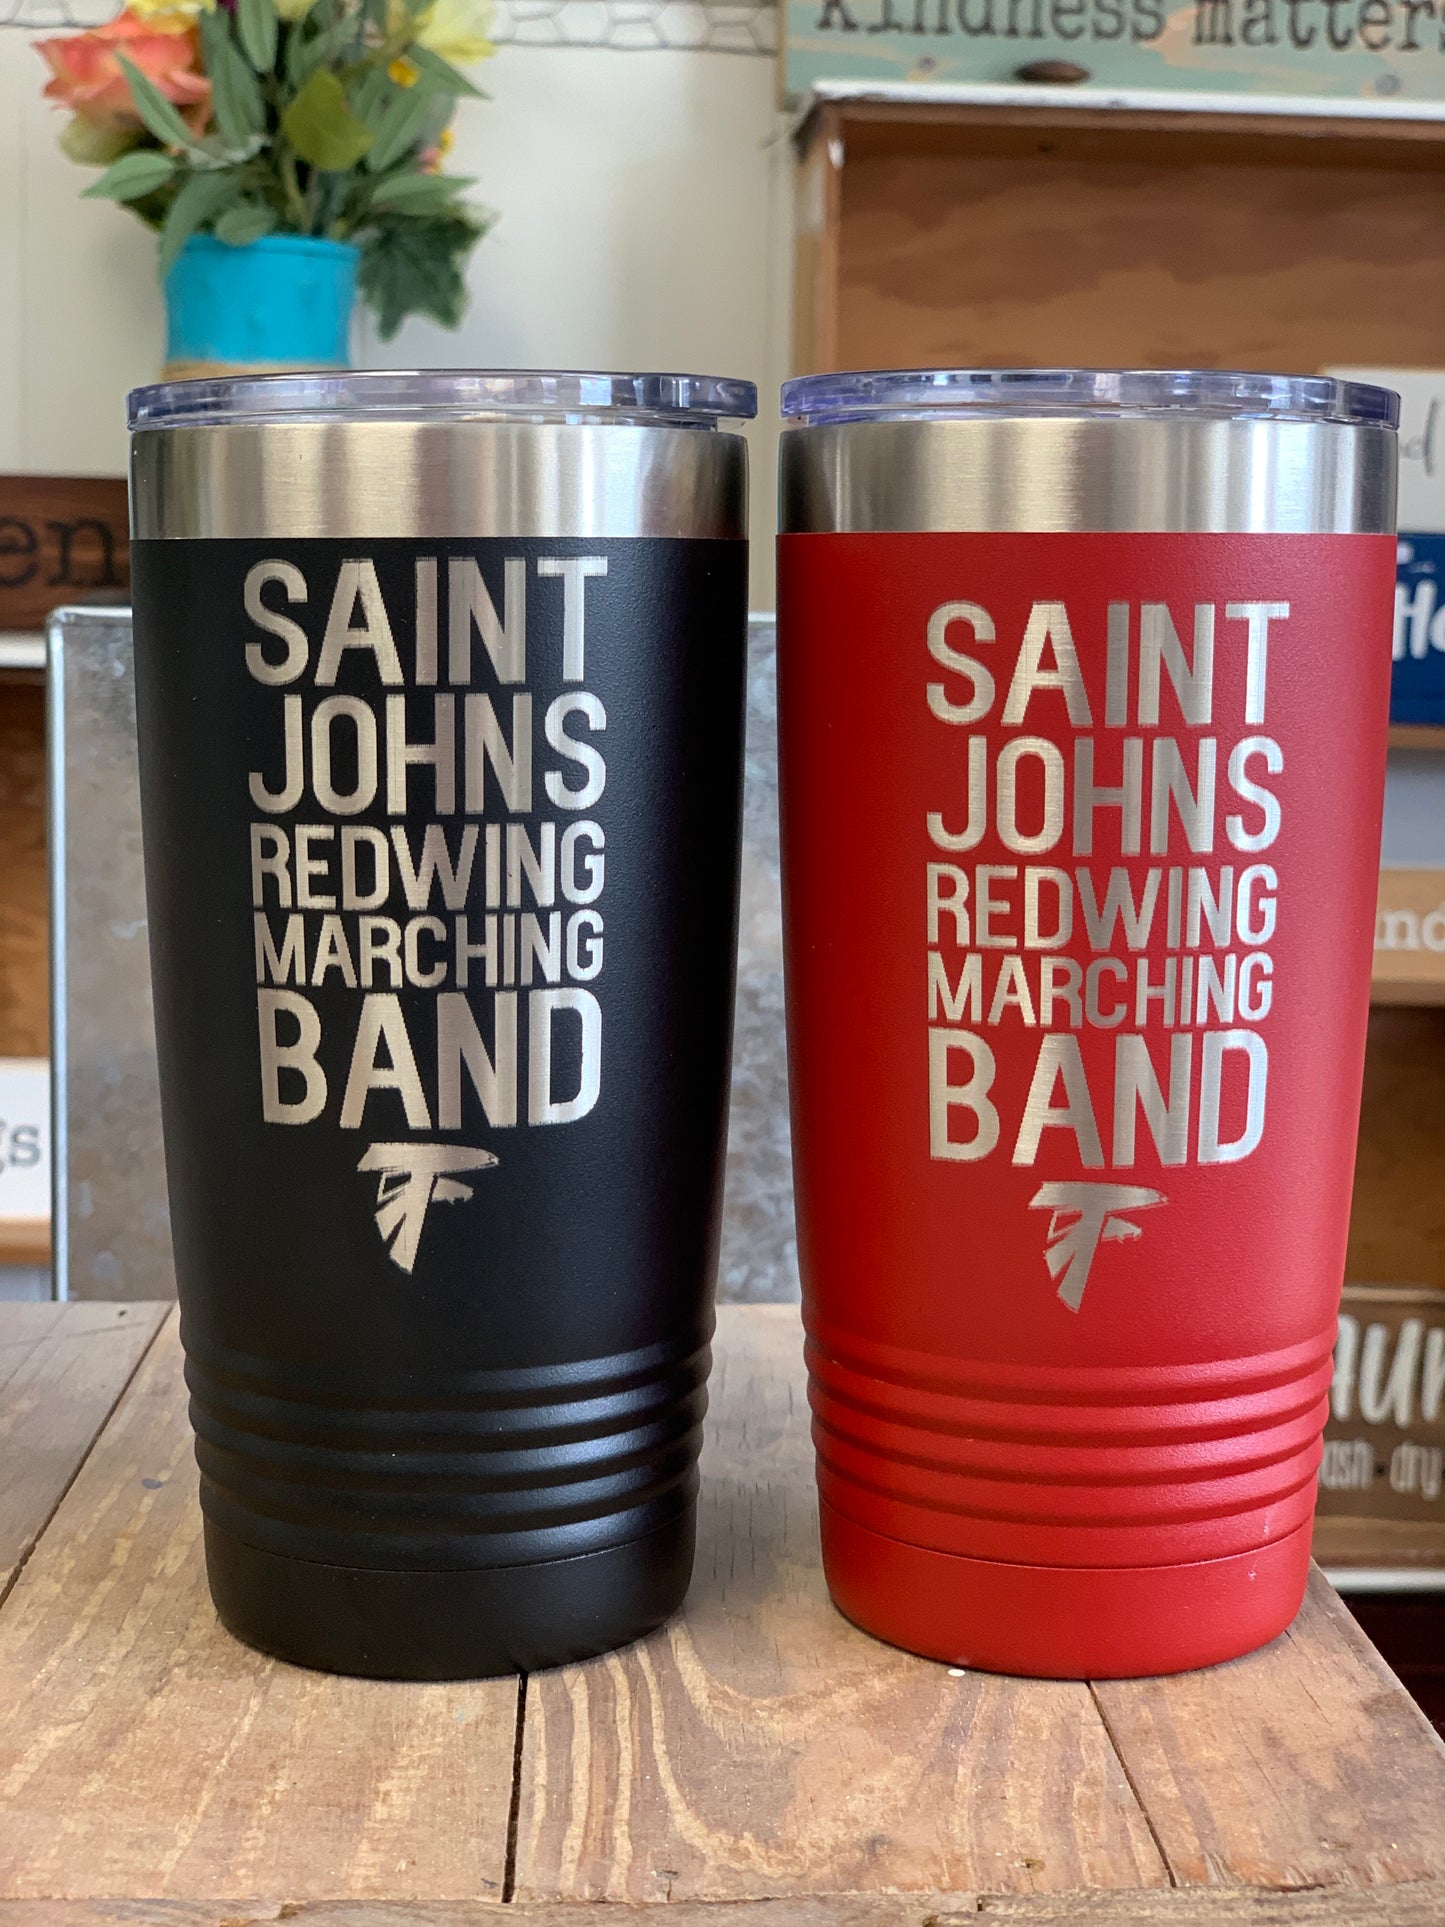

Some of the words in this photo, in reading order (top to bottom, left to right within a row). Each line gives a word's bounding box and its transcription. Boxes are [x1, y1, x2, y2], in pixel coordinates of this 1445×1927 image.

[1192, 0, 1445, 52] matter
[244, 556, 608, 686] SAINT
[927, 600, 1290, 728] SAINT
[249, 691, 607, 816] JOHNS
[927, 735, 1284, 857] JOHNS
[250, 820, 606, 911] REDWING
[927, 862, 1278, 952] REDWING
[254, 909, 604, 989] MARCHING
[928, 950, 1274, 1028] MARCHING
[257, 987, 603, 1130] BAND
[928, 1027, 1269, 1169] BAND
